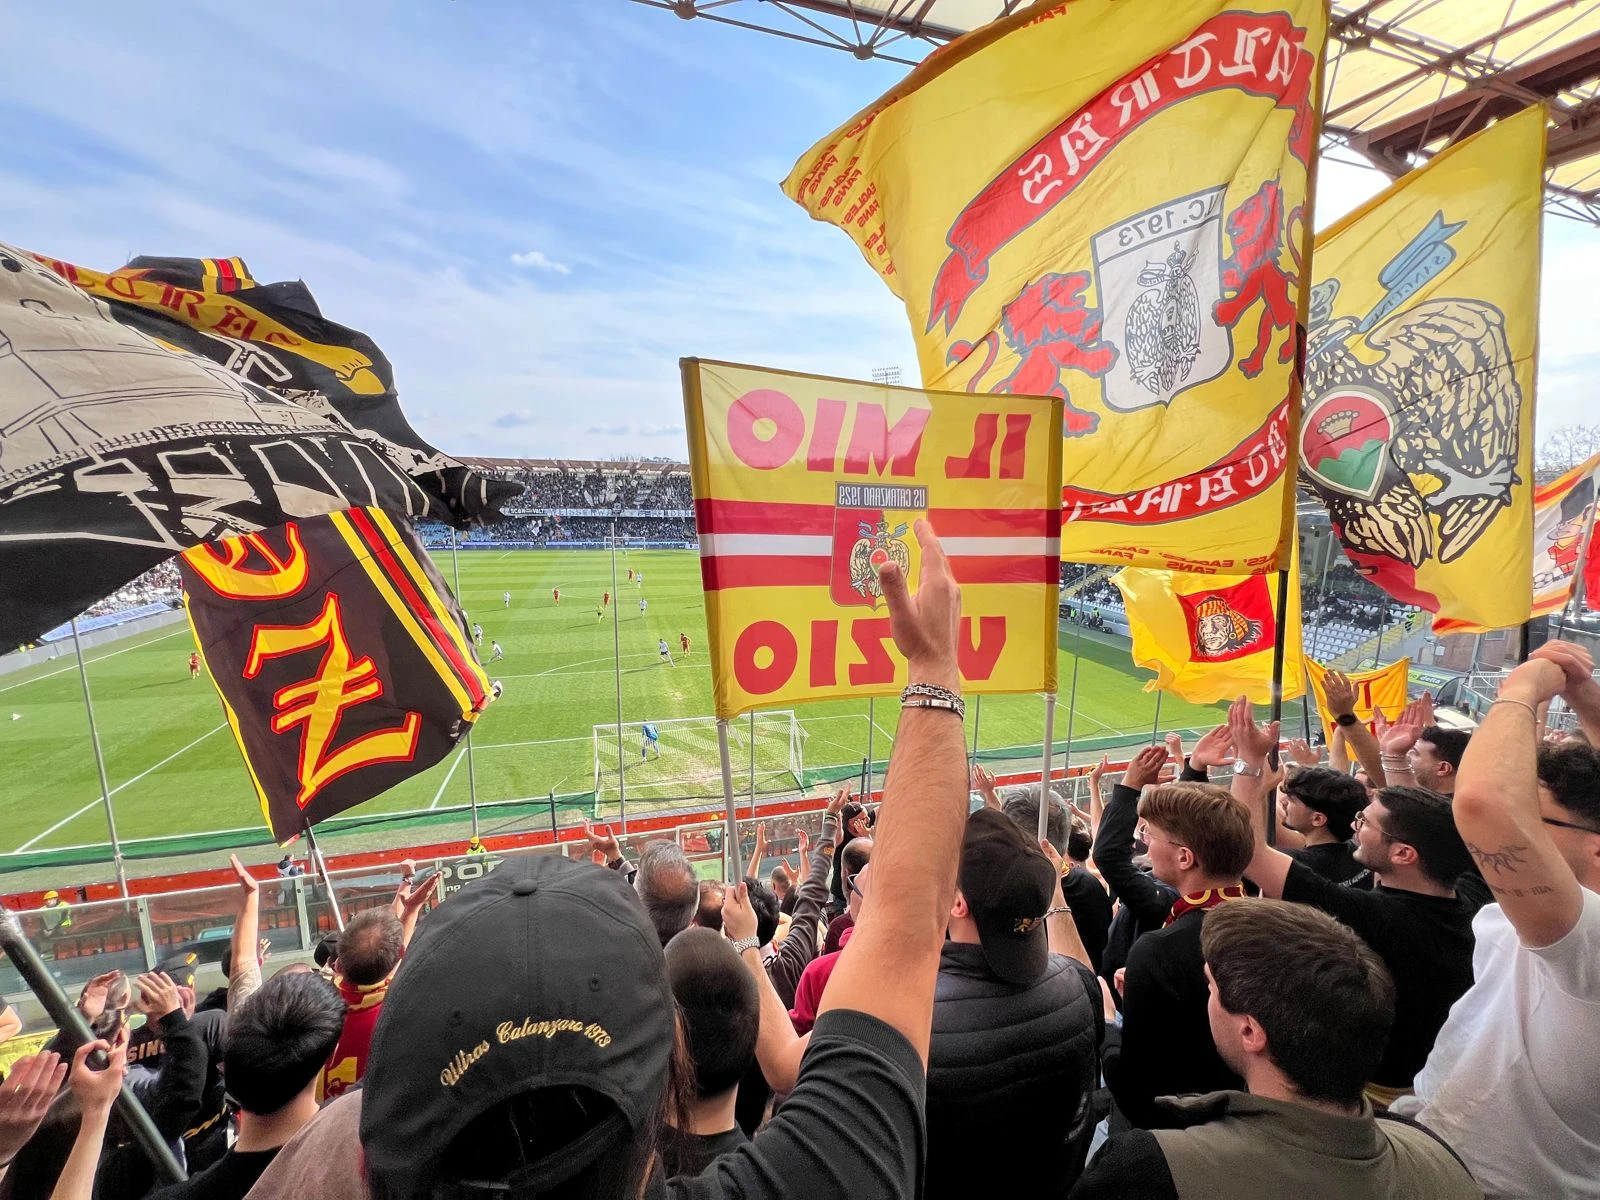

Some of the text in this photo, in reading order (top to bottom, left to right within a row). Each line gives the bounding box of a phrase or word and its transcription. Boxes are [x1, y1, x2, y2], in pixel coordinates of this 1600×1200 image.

[440, 1016, 612, 1086] Ultras Catanzaro 1973
